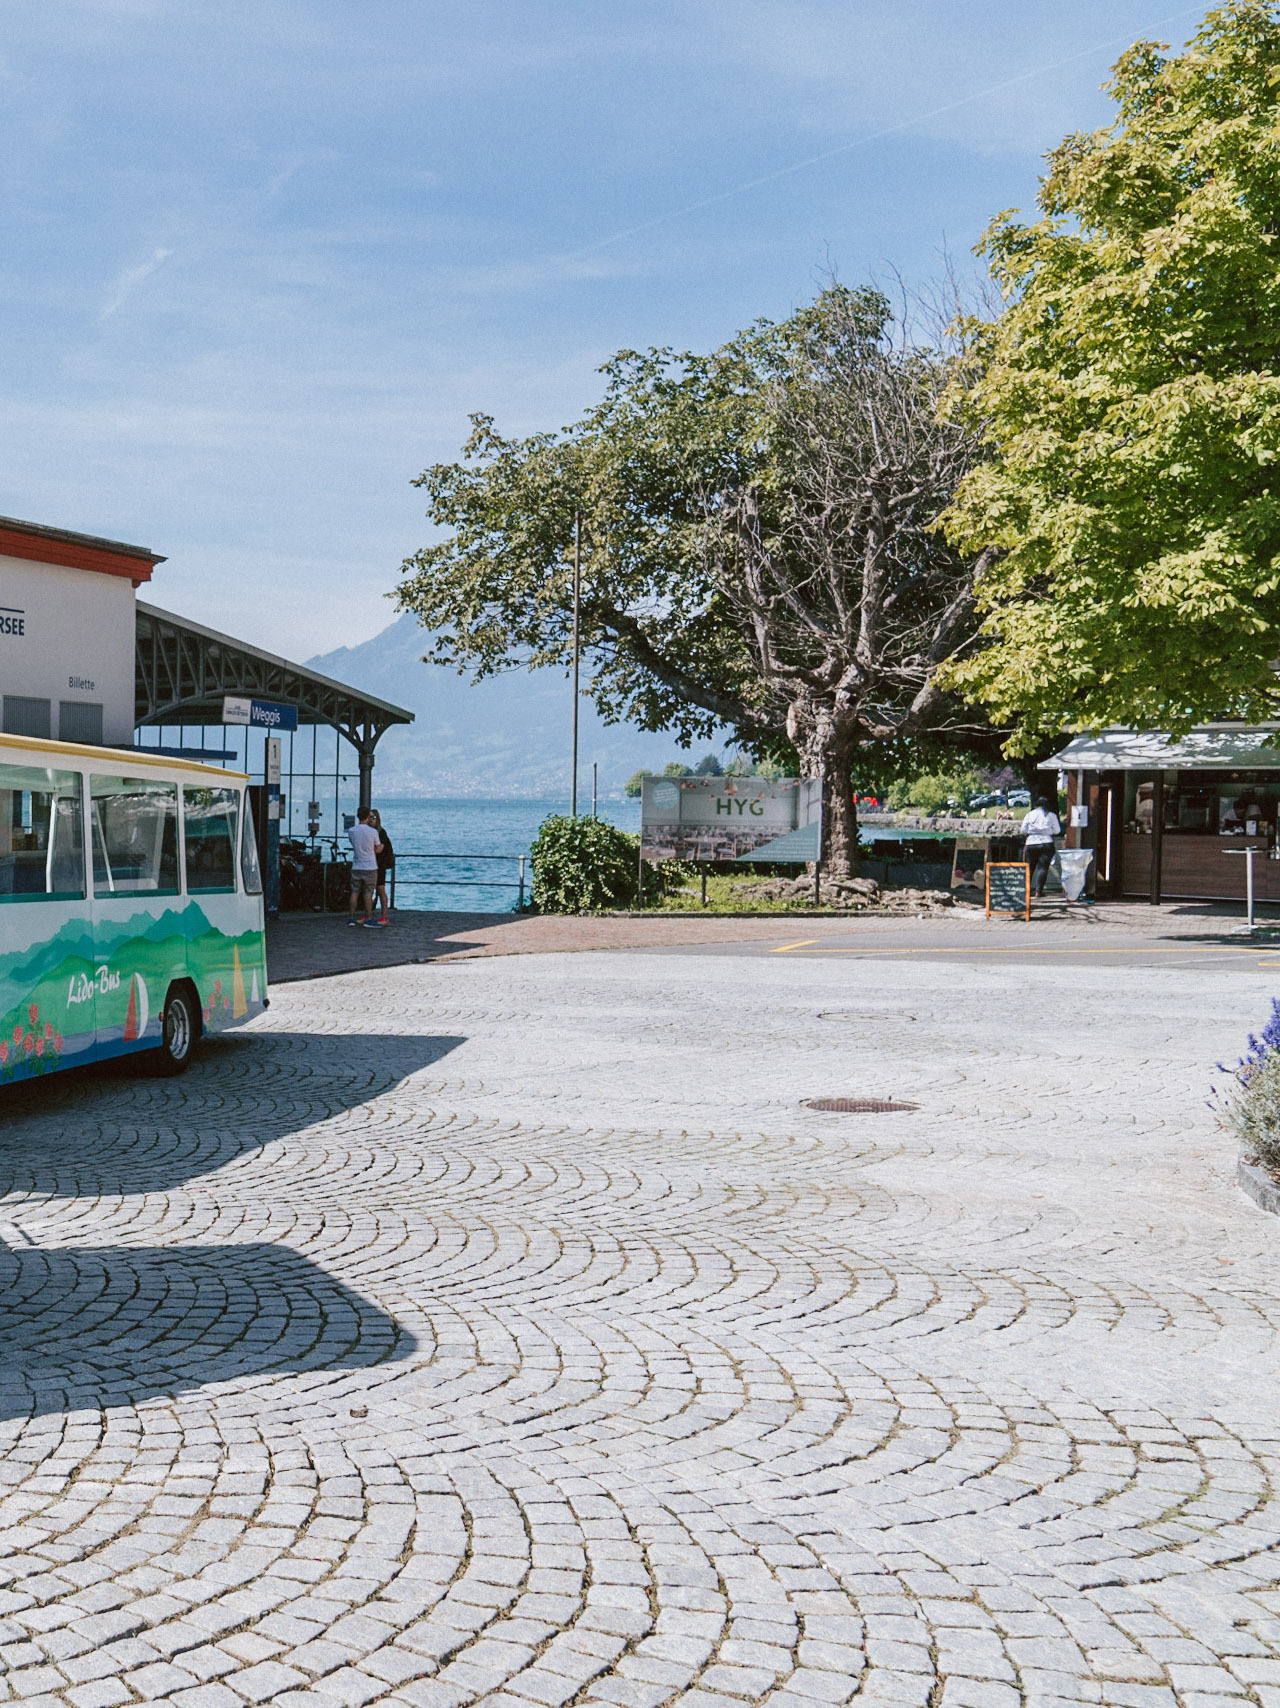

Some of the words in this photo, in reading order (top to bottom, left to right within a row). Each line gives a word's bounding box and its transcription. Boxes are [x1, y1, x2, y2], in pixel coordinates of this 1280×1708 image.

[68, 676, 95, 690] Billette
[252, 706, 280, 726] Weggis
[716, 798, 764, 816] HYG
[66, 964, 120, 1009] Lido-Bus
